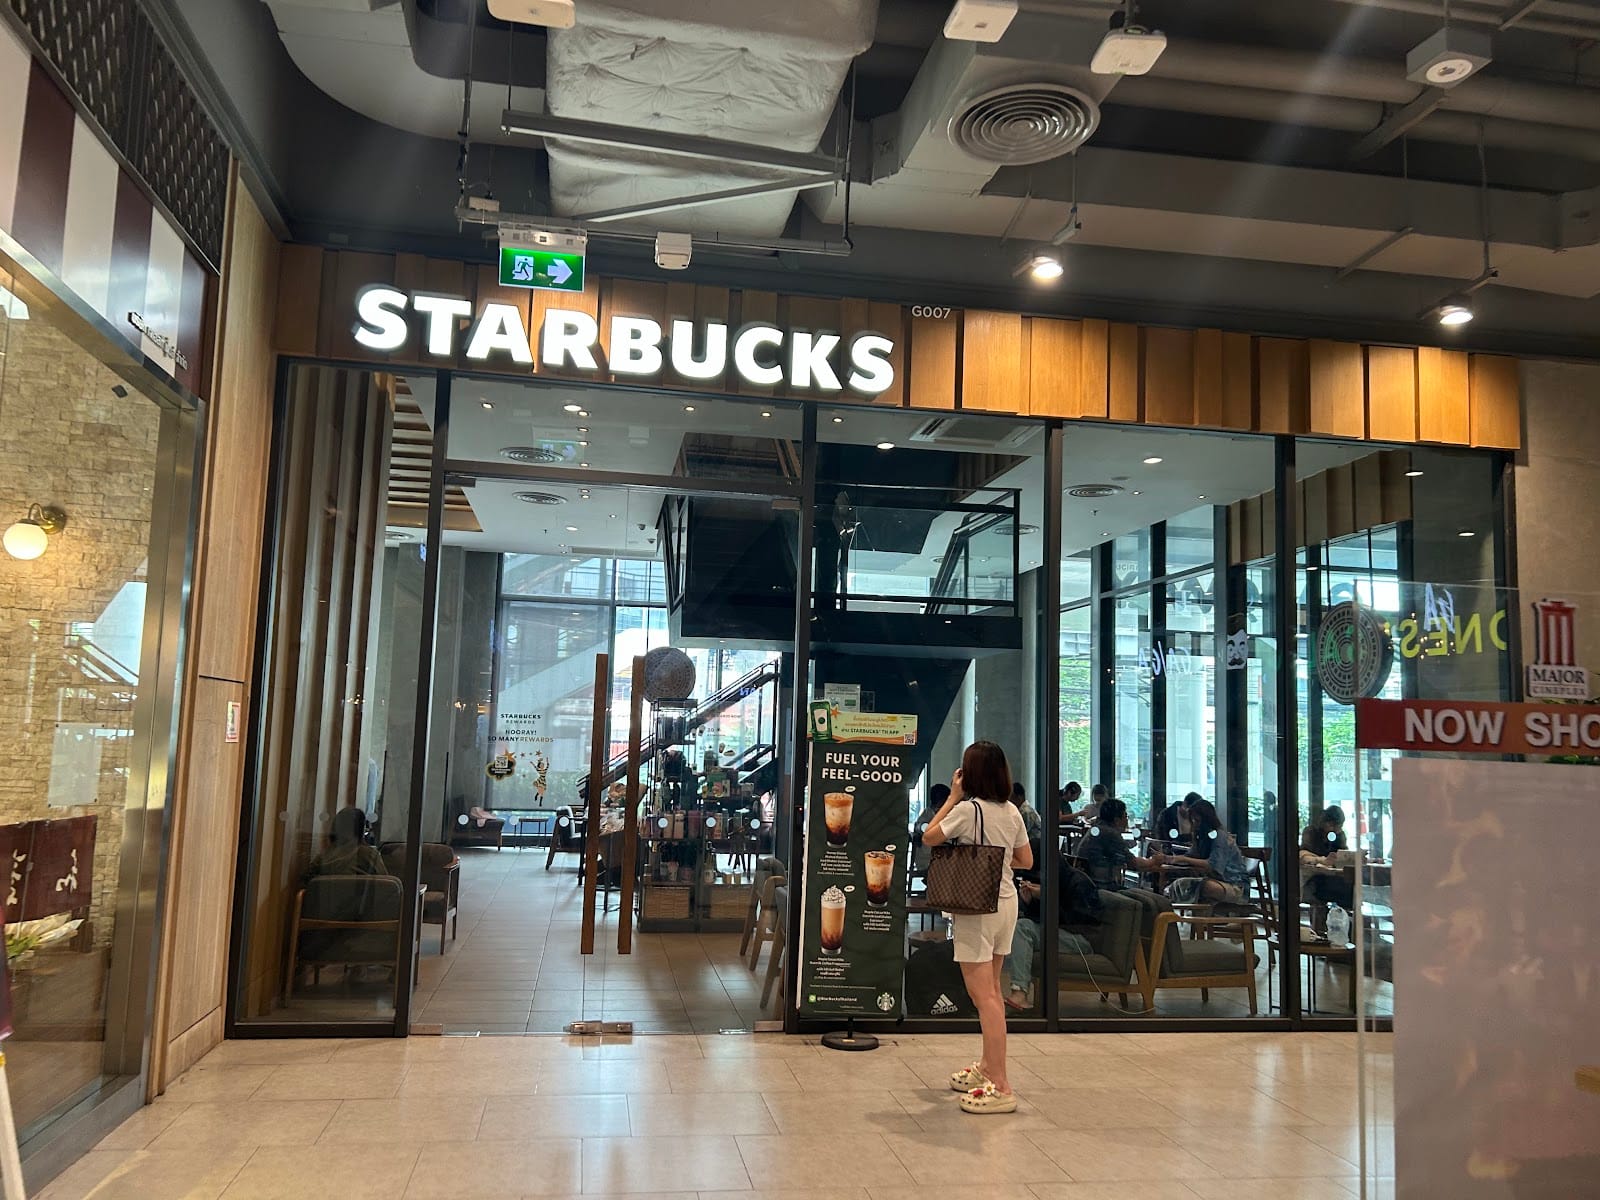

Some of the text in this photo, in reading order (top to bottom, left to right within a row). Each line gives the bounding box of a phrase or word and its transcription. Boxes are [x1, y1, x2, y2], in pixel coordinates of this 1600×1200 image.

[911, 305, 952, 320] G007
[352, 286, 897, 394] STARBUCKS
[1532, 668, 1586, 684] MAJOR
[1532, 686, 1587, 696] CINEPLEX
[1404, 708, 1600, 749] NOW SHO
[825, 752, 900, 767] FUEL YOUR
[822, 768, 902, 783] FEEL-GOOD
[930, 1004, 958, 1015] adidas
